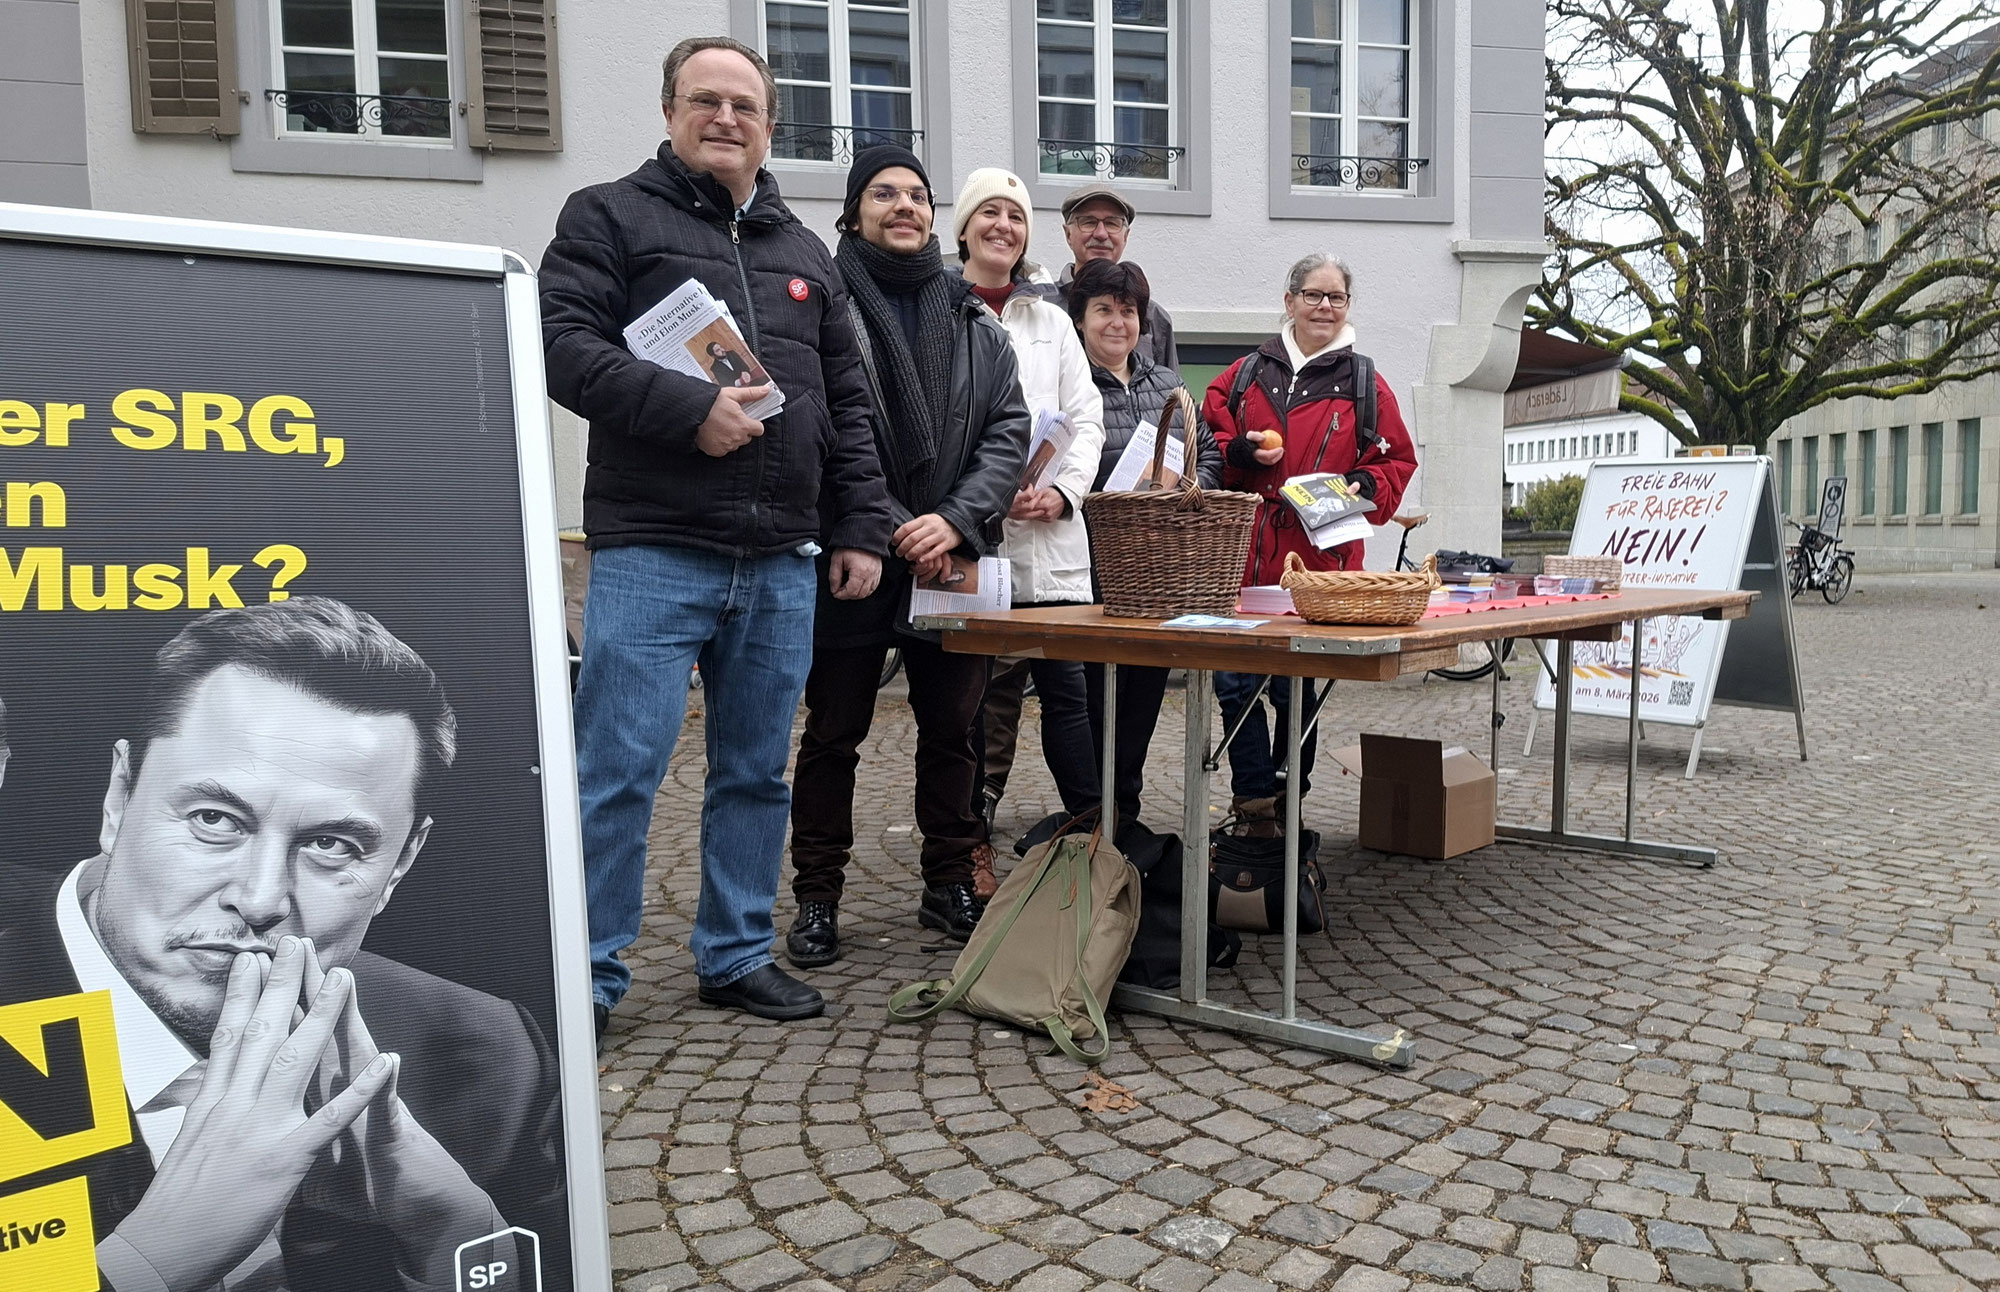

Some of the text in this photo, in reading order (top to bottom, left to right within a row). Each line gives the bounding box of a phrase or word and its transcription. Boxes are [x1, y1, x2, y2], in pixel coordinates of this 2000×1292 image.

[791, 283, 804, 294] SP
[638, 324, 656, 340] «Die
[656, 291, 698, 328] Alternative
[643, 333, 660, 349] und
[659, 320, 679, 337] Elon
[677, 302, 704, 324] Musk»
[111, 388, 345, 468] SRG,
[1668, 471, 1717, 492] BAHN
[1605, 499, 1638, 521] FÜR
[1600, 524, 1707, 566] NEIN!
[1575, 687, 1591, 697] am
[1593, 686, 1603, 698] 8.
[1639, 691, 1660, 703] 026
[469, 1261, 507, 1288] SP
